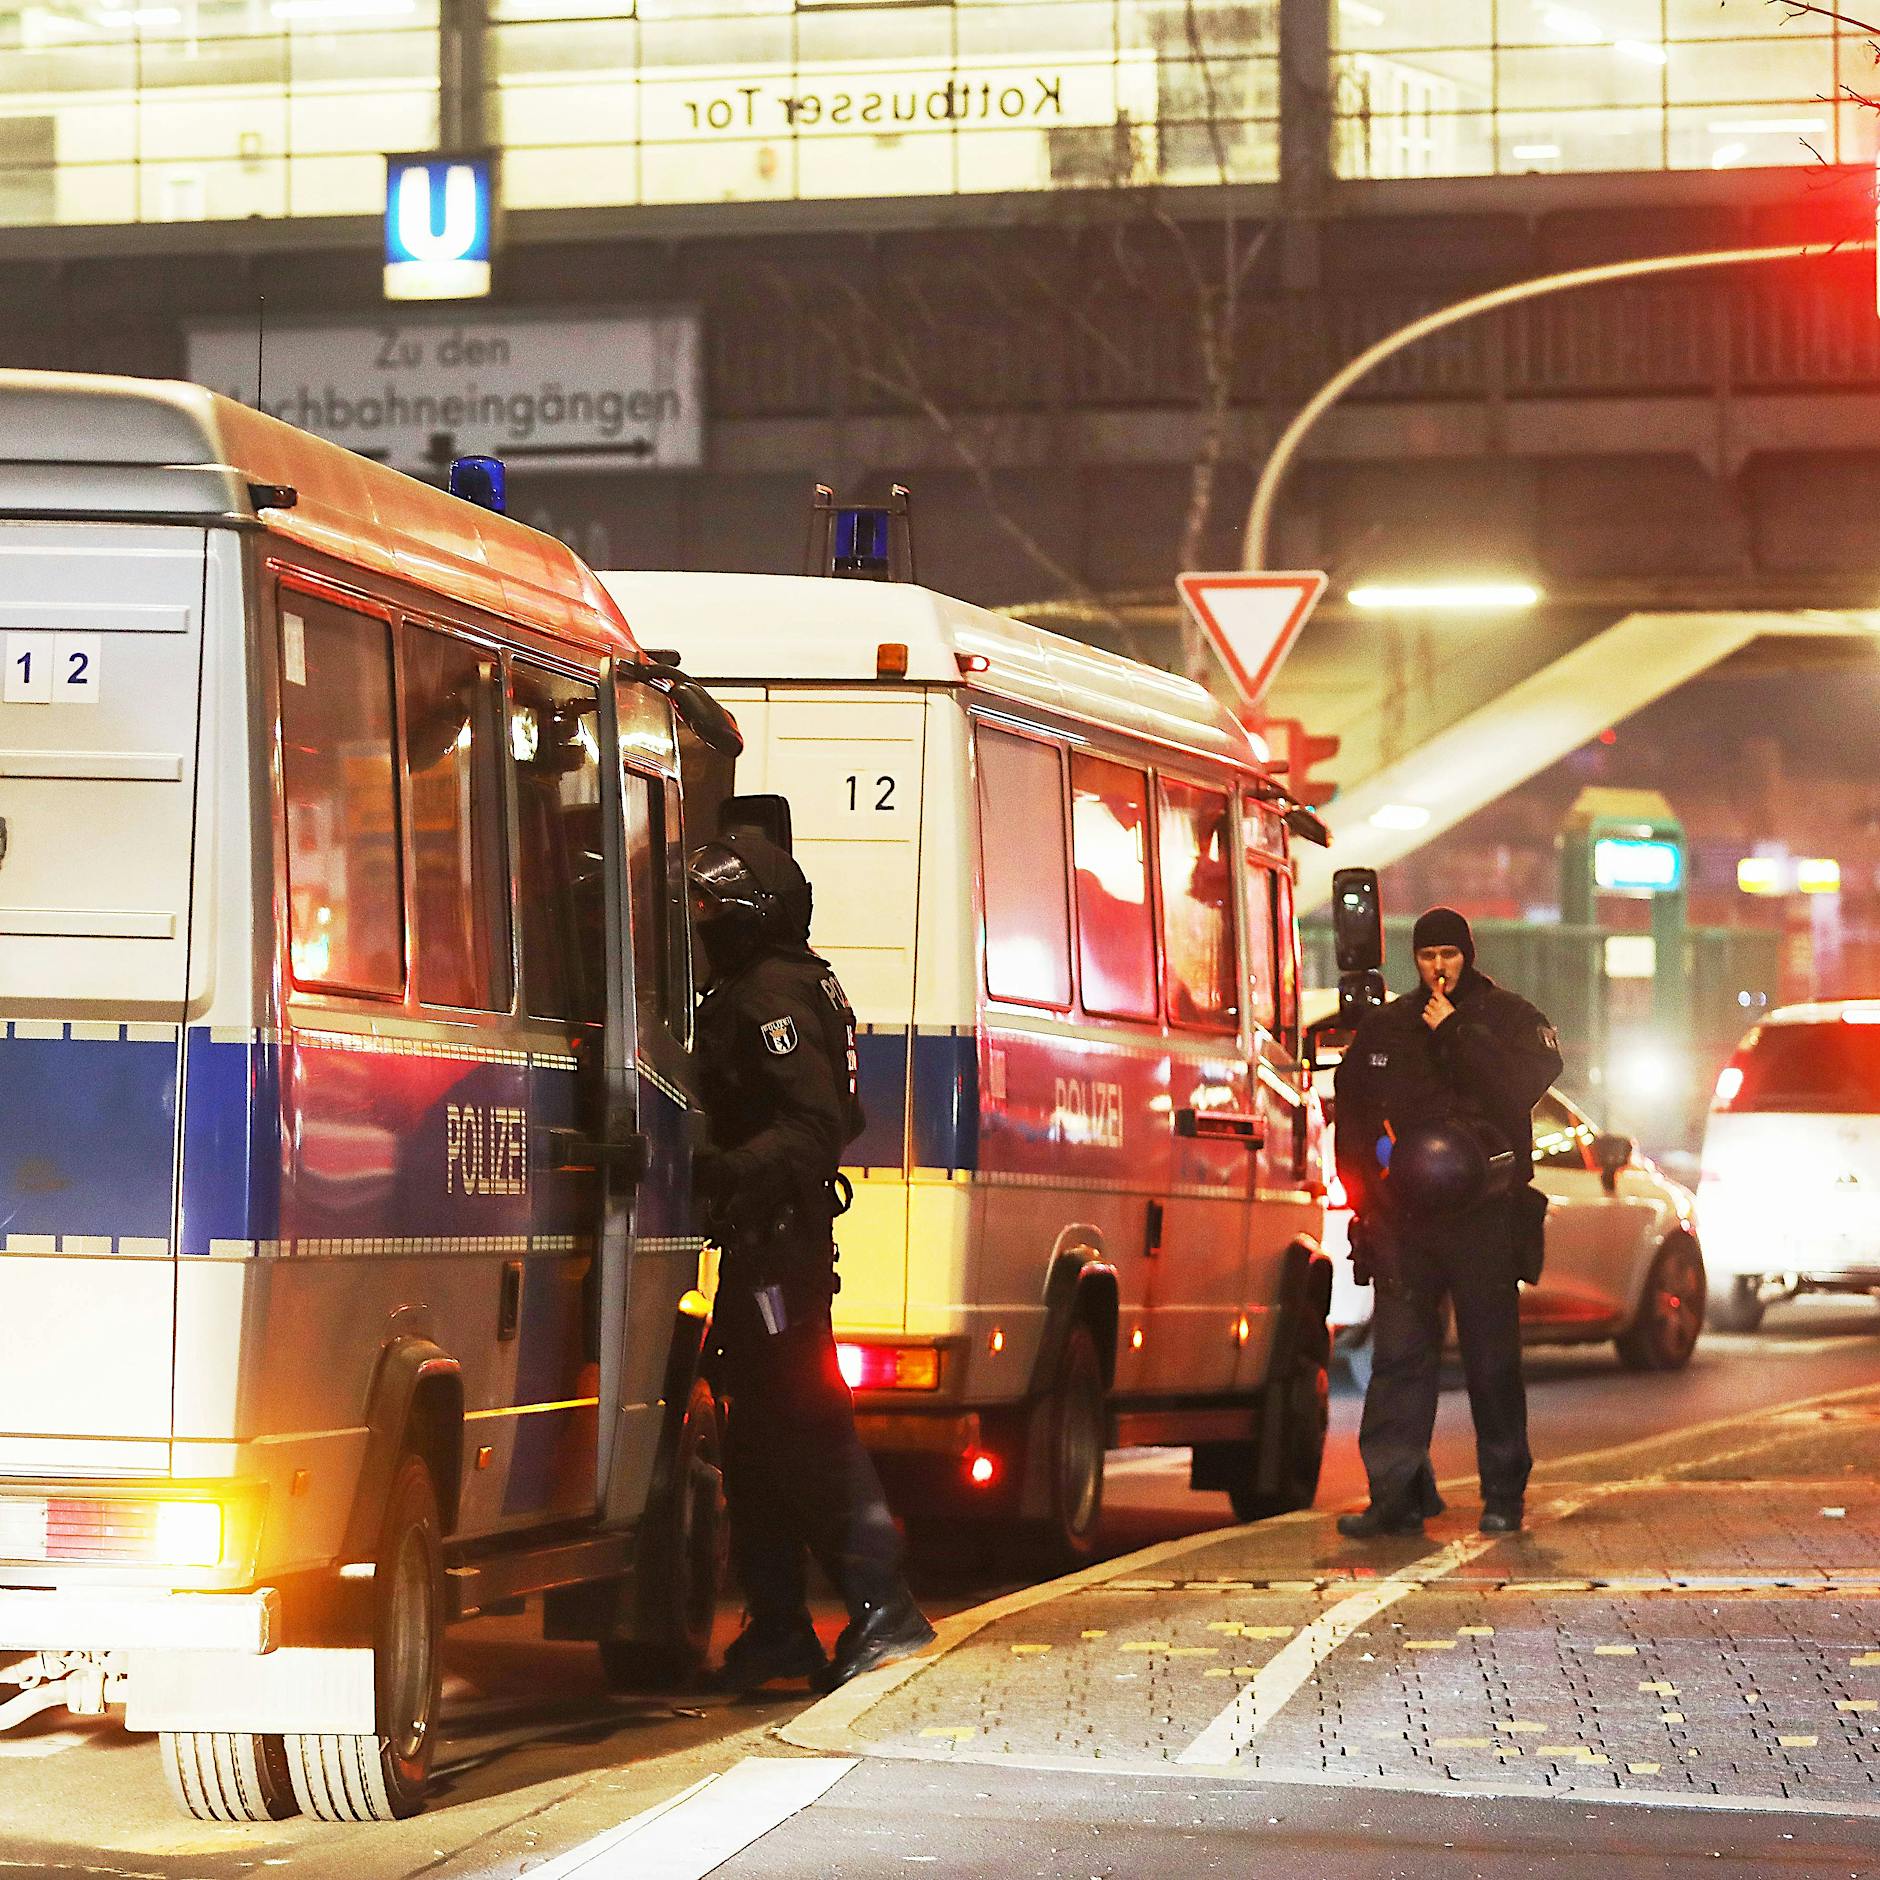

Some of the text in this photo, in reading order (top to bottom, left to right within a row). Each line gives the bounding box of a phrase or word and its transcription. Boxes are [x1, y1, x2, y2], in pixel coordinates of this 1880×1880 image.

[398, 165, 476, 262] U
[374, 328, 511, 368] Zu den
[228, 381, 681, 437] chbahneingängen
[1055, 1077, 1124, 1148] POLIZEI
[446, 1103, 527, 1195] POLIZEI
